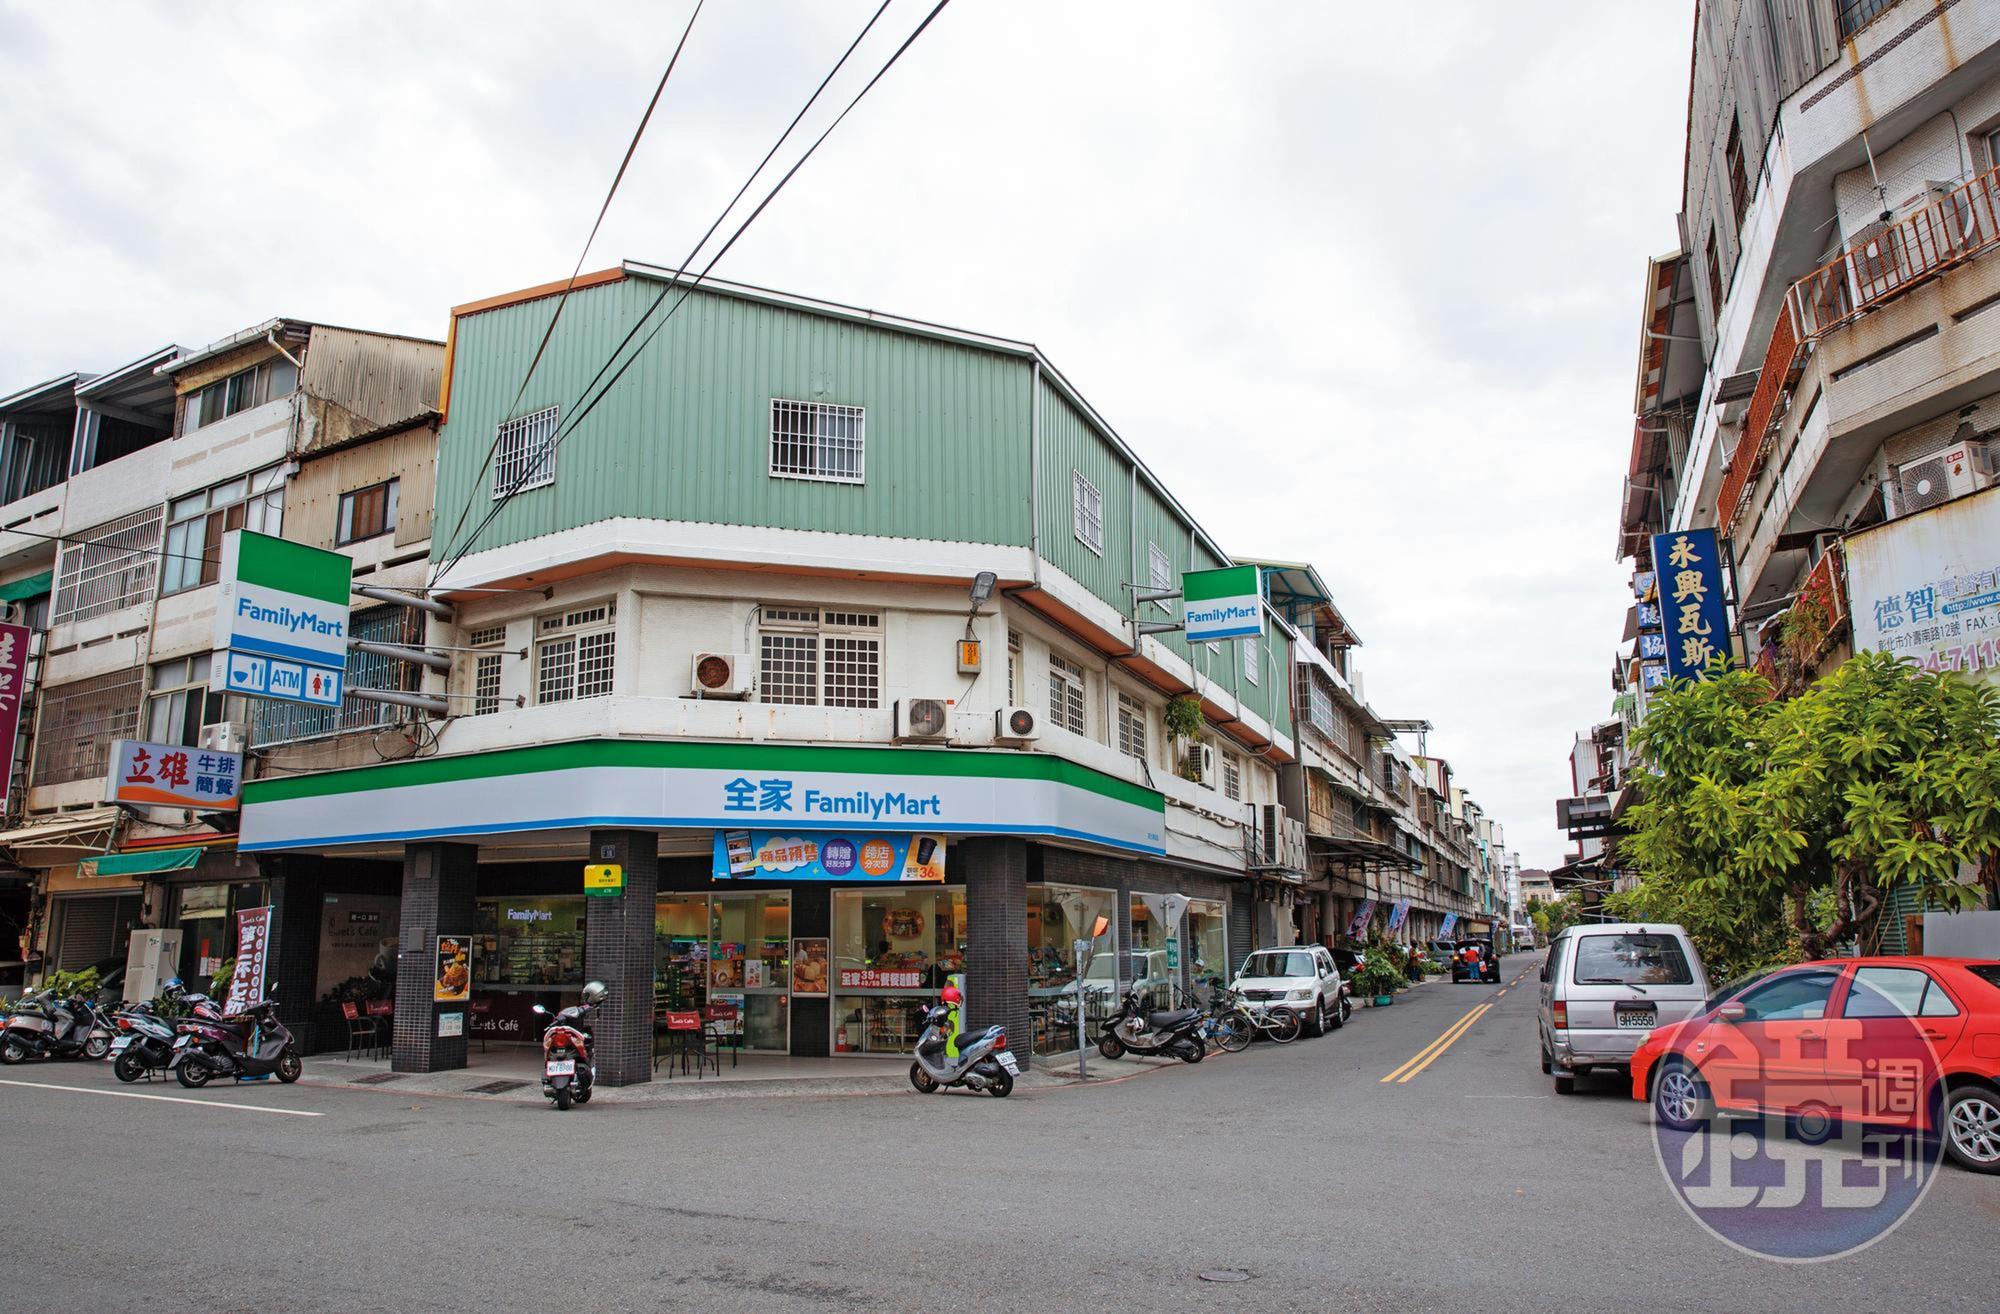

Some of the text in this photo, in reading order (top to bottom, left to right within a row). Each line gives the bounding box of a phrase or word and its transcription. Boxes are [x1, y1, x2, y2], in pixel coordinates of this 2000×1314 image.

[238, 597, 342, 637] FamilyMart
[1187, 606, 1256, 623] FamilyMart
[1873, 586, 1934, 632] 德智
[1878, 621, 1961, 650] 彰化市介壽南路12號
[271, 669, 300, 689] ATM
[126, 747, 189, 790] 立雄
[198, 754, 235, 774] 牛排
[196, 775, 233, 796] 簡餐
[723, 777, 940, 820] 全家 FamilyMart
[759, 843, 818, 863] 商品預售
[223, 925, 256, 1015] 第二杯七折
[498, 1019, 519, 1031] Café
